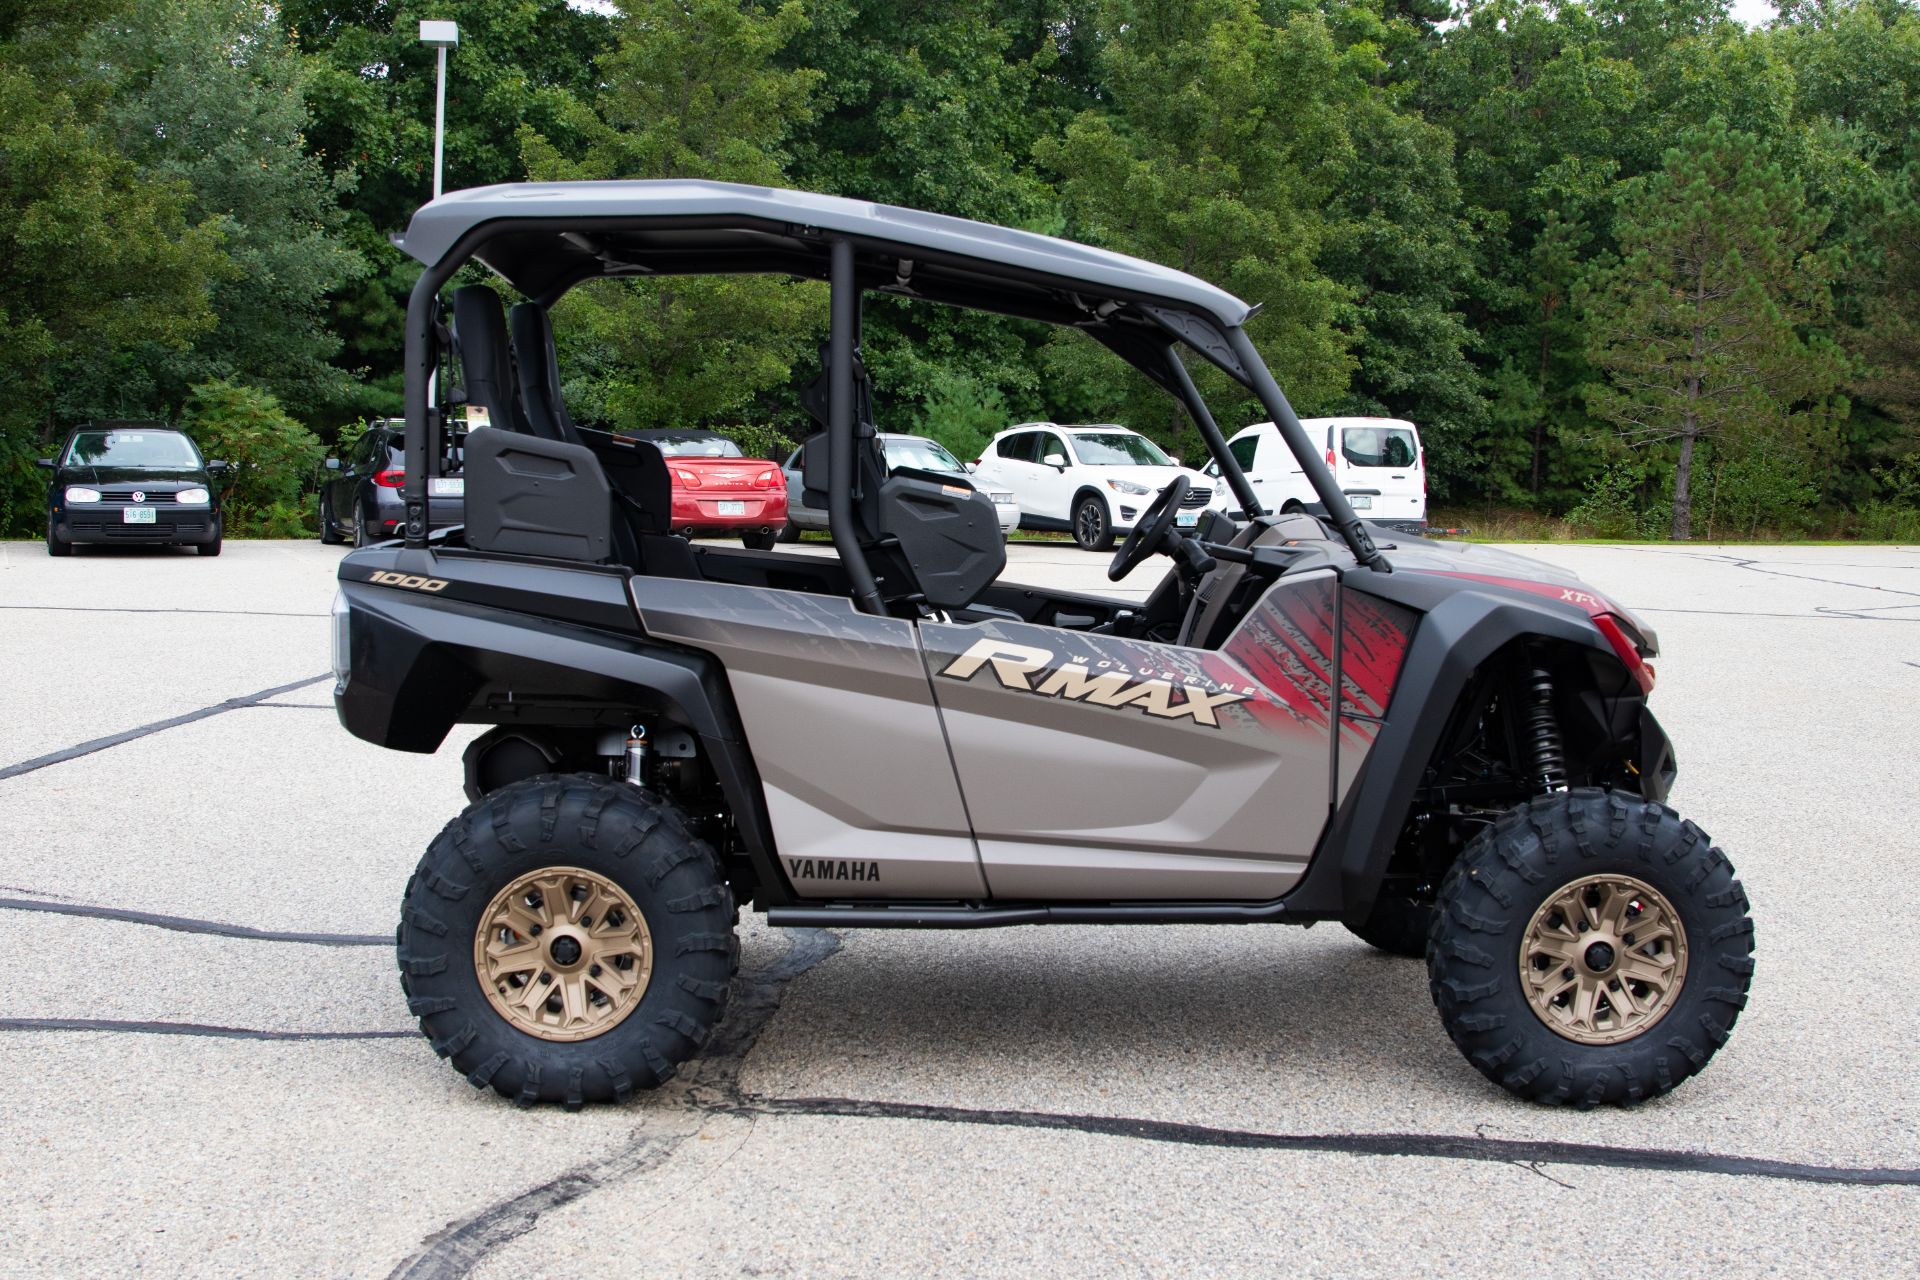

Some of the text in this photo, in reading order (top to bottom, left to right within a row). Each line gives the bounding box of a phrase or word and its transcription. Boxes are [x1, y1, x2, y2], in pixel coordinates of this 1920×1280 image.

[368, 570, 450, 592] 1000
[936, 638, 1250, 729] RMAX
[788, 858, 880, 882] YAMAHA
